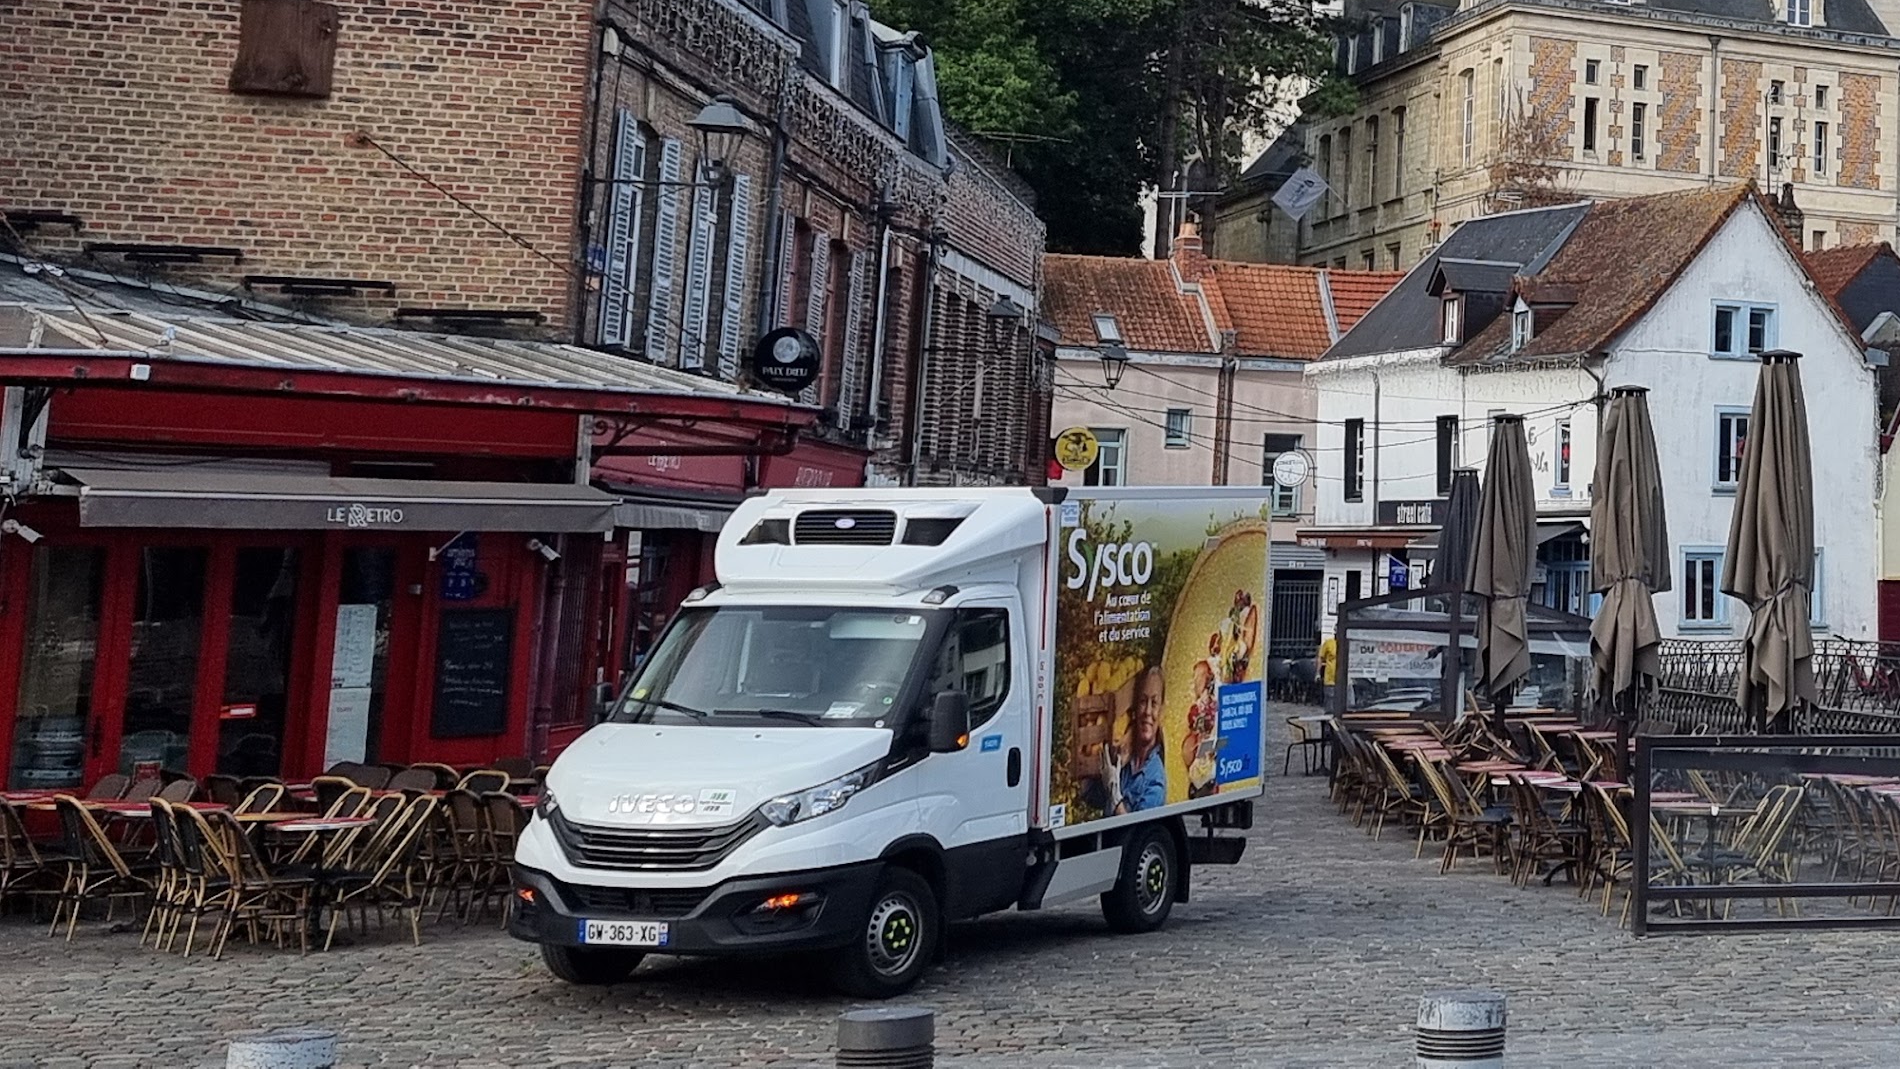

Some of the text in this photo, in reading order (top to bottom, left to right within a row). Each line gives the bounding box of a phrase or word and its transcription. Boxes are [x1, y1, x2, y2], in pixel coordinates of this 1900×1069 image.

[327, 507, 346, 522] LE
[1067, 528, 1153, 603] Sysco
[608, 792, 696, 815] IVECO
[587, 923, 657, 943] GW-363-XG
